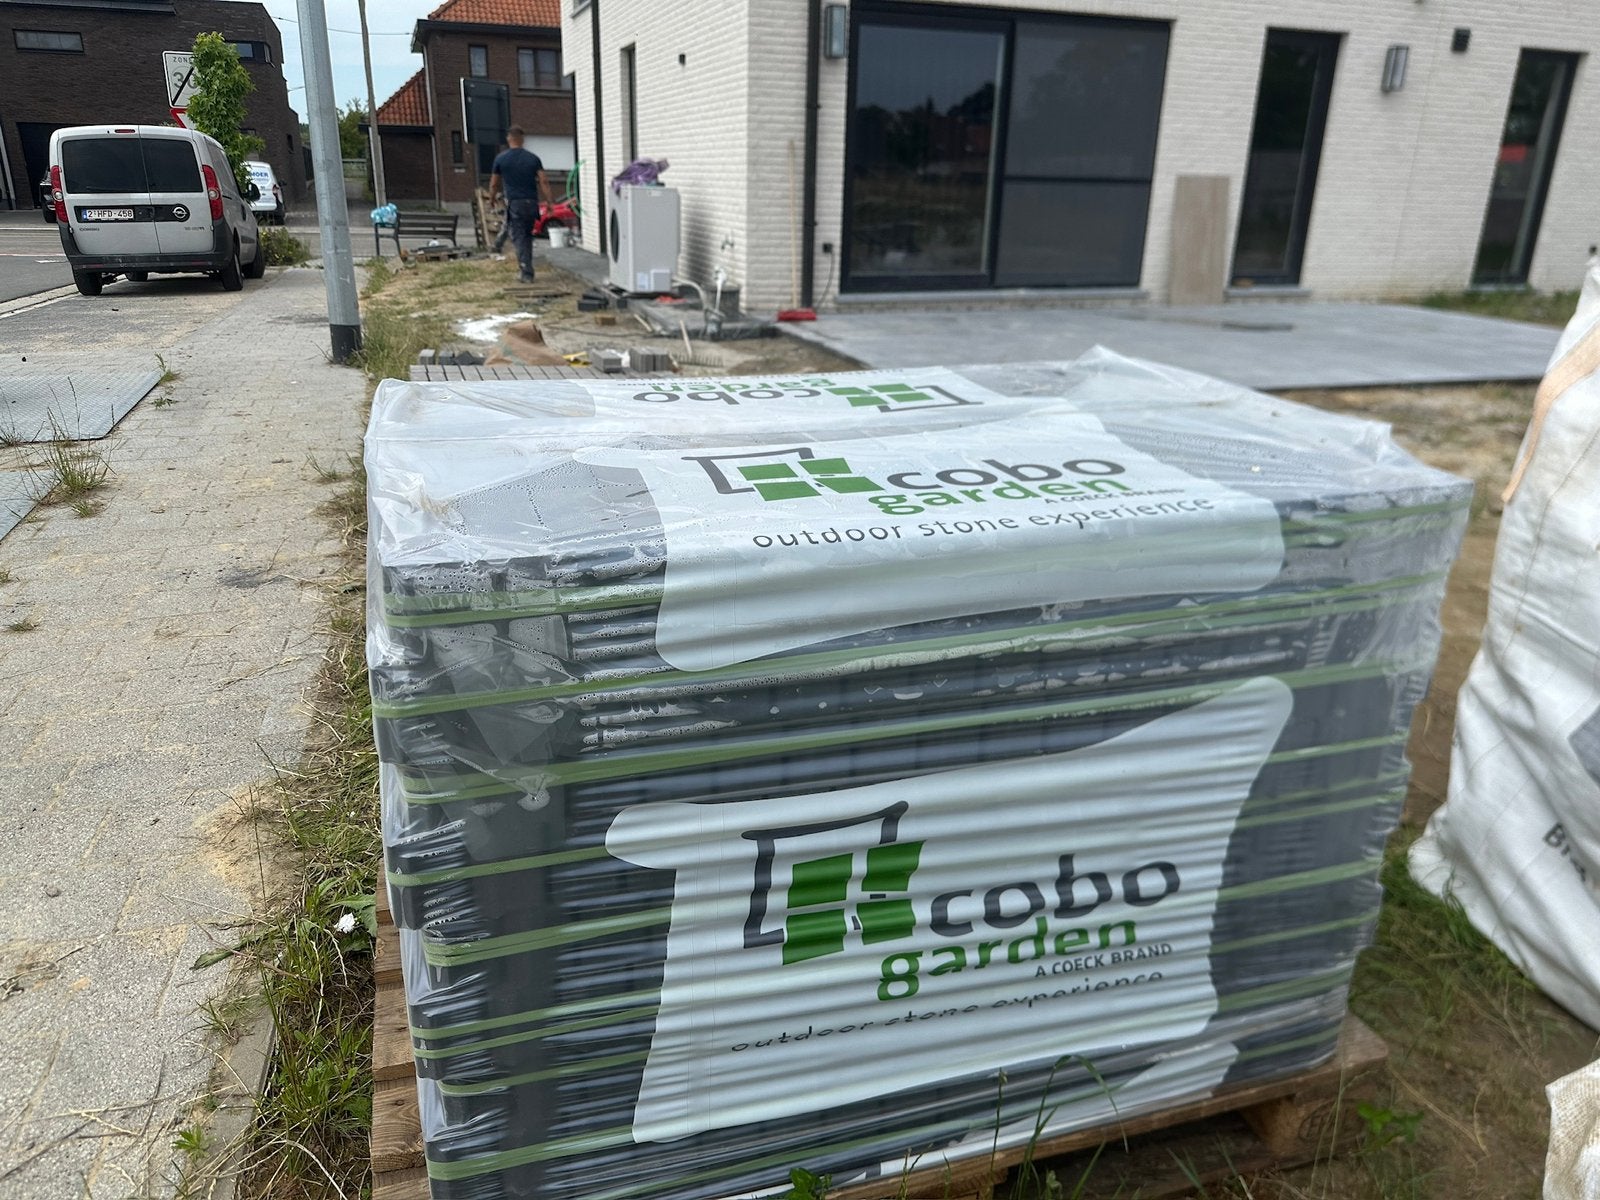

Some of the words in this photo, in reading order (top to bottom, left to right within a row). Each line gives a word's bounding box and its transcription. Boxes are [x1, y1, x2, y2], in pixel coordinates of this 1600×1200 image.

[633, 387, 822, 405] cobo
[886, 457, 1126, 490] cobo
[868, 477, 1131, 516] garden
[752, 523, 902, 548] outdoor
[922, 511, 1020, 537] stone
[1033, 496, 1216, 530] experience
[929, 853, 1181, 937] cobo
[876, 916, 1138, 1001] garden
[1034, 964, 1048, 977] A
[1051, 954, 1106, 976] COECK
[1110, 942, 1173, 965] BRAND
[731, 1020, 875, 1052] outdoor
